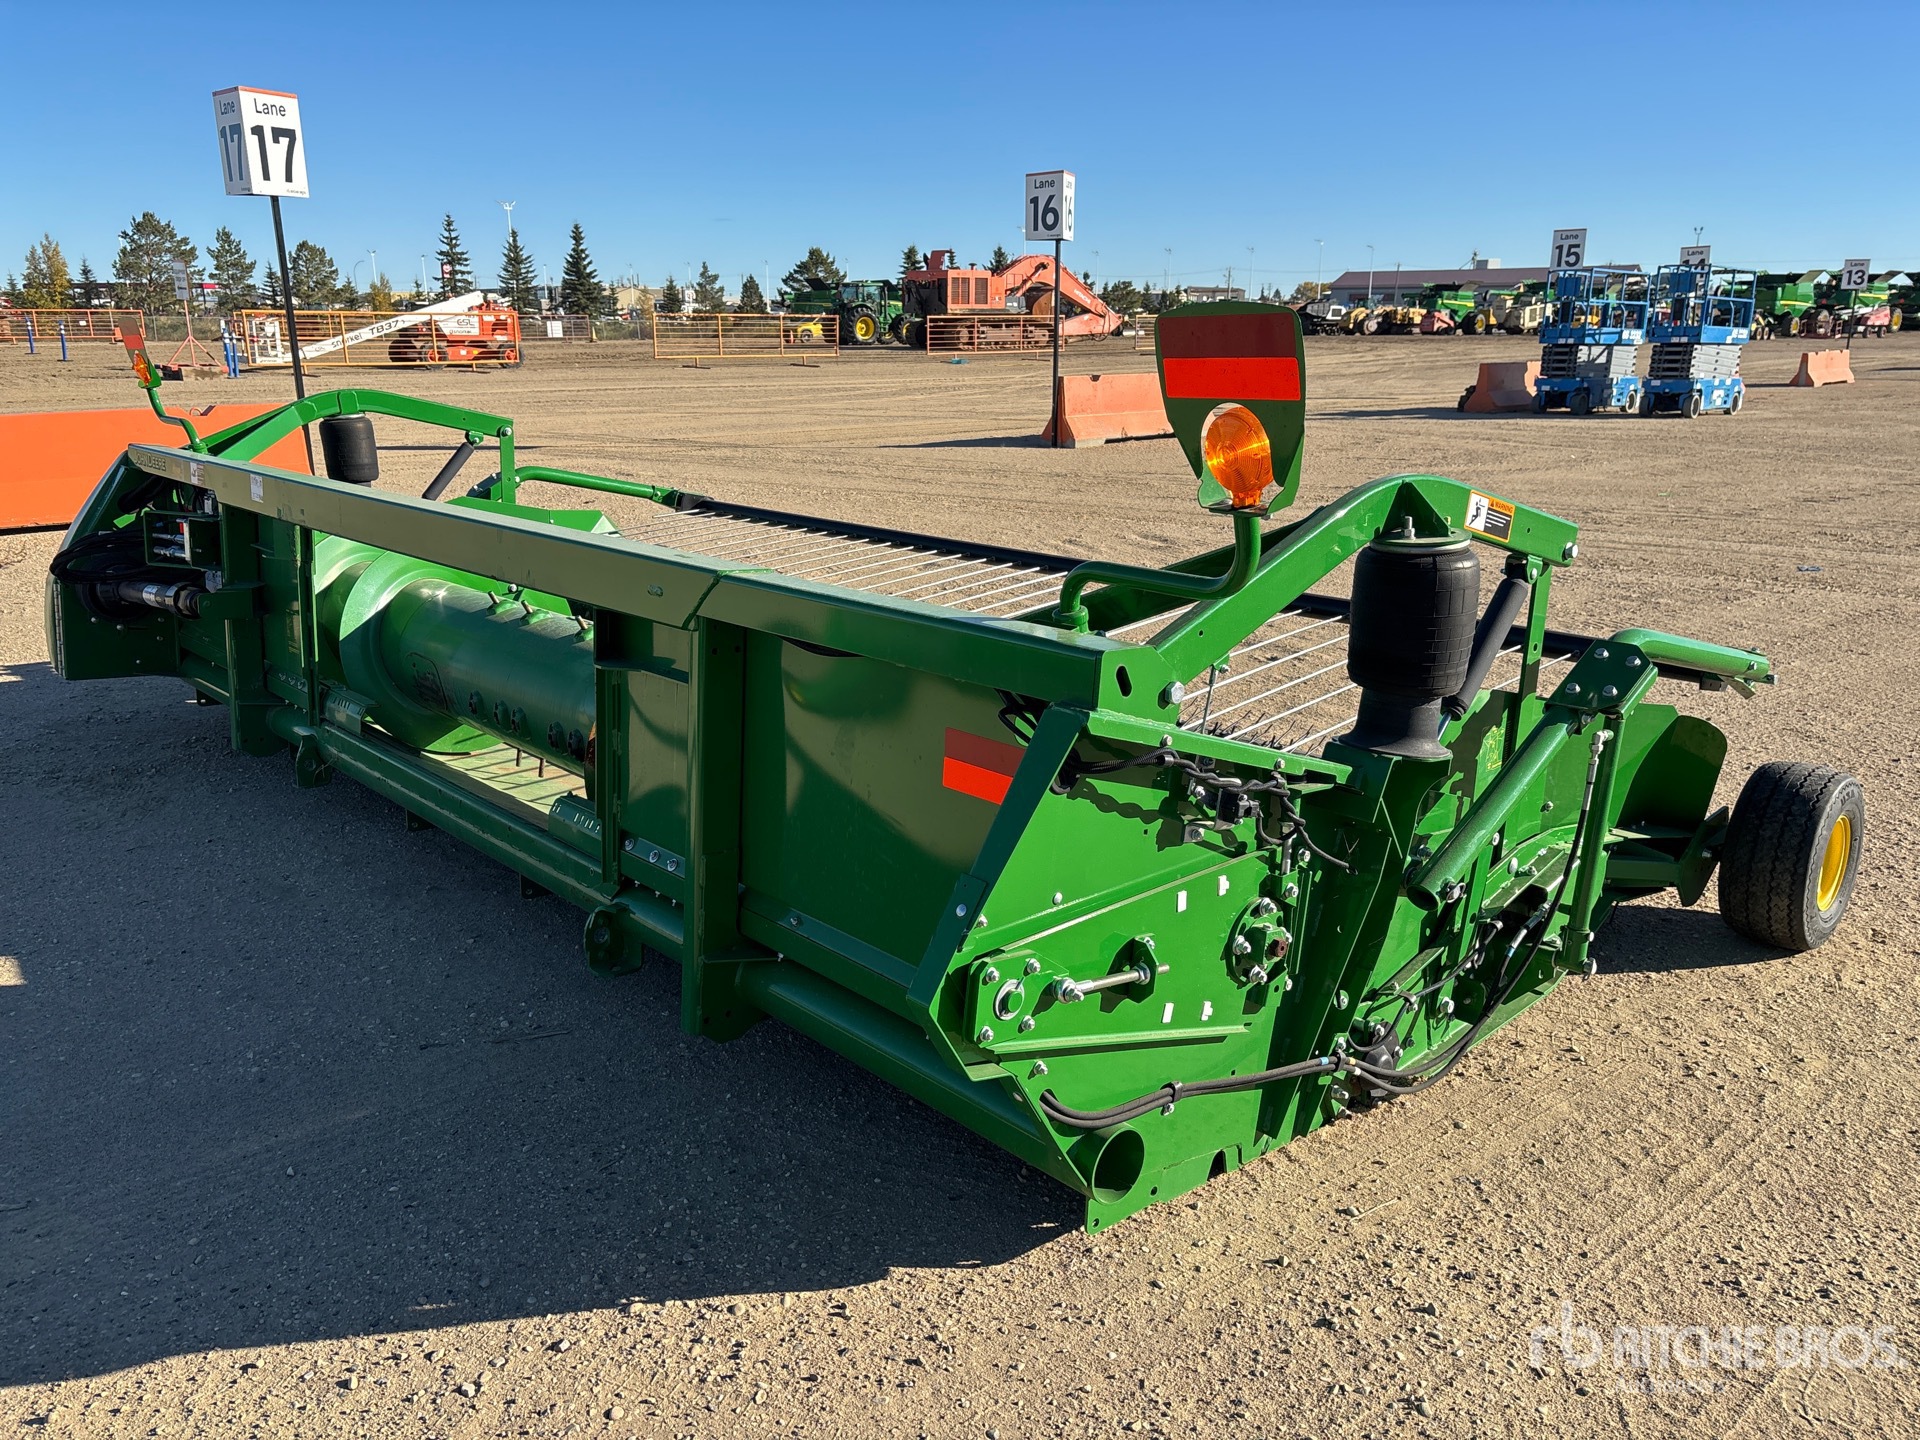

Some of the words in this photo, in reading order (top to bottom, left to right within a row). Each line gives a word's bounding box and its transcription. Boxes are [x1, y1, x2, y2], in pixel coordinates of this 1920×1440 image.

[219, 100, 236, 116] Lane
[253, 97, 287, 117] Lane
[220, 122, 244, 182] 17
[250, 124, 297, 183] 17
[1034, 179, 1056, 189] Lane
[1029, 193, 1060, 232] 16
[1555, 243, 1581, 268] 15
[1846, 269, 1866, 286] 13
[331, 332, 363, 349] snrkel
